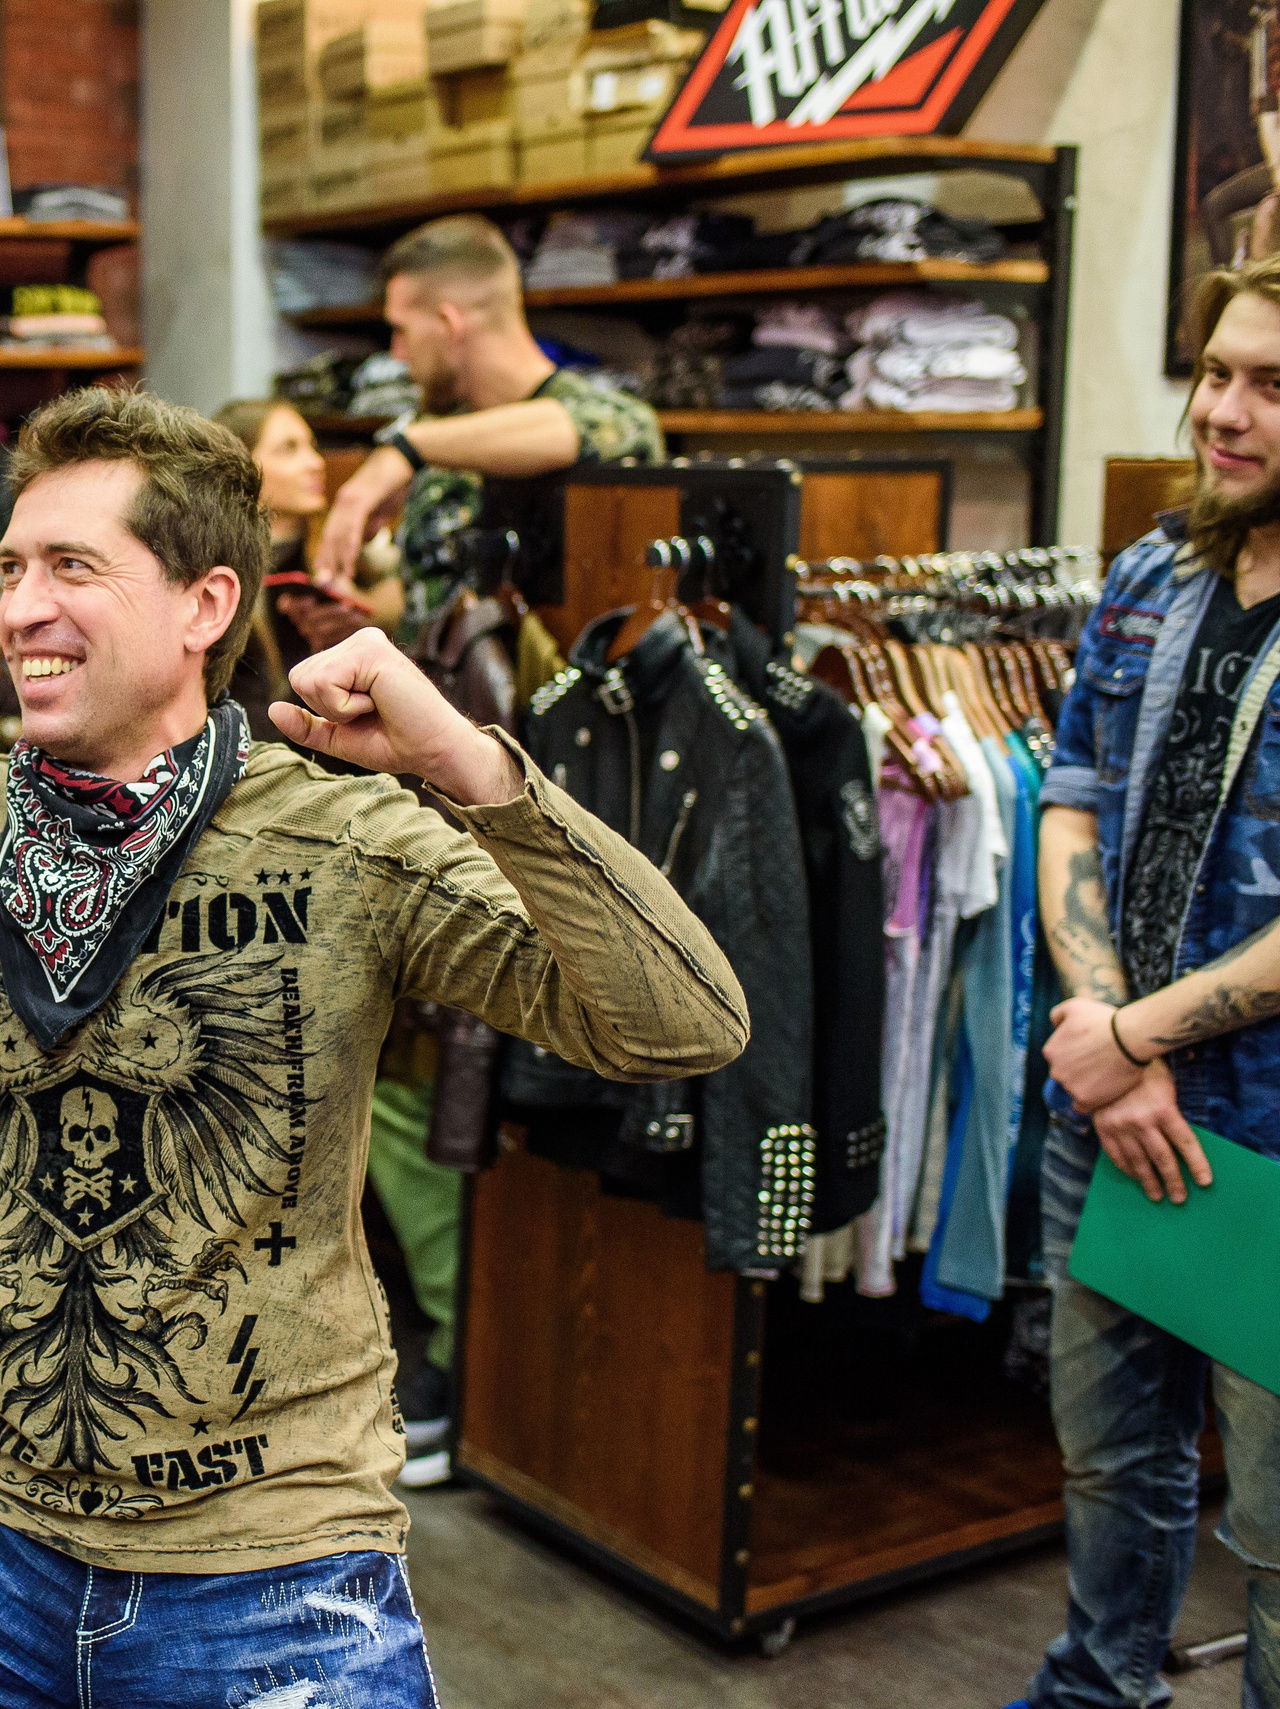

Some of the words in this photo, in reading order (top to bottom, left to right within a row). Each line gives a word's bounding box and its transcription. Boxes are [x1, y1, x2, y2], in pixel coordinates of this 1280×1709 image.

[280, 967, 303, 1052] DEATH
[287, 1064, 307, 1129] FROM
[281, 1135, 306, 1210] ABOVE
[130, 1433, 269, 1491] FAST
